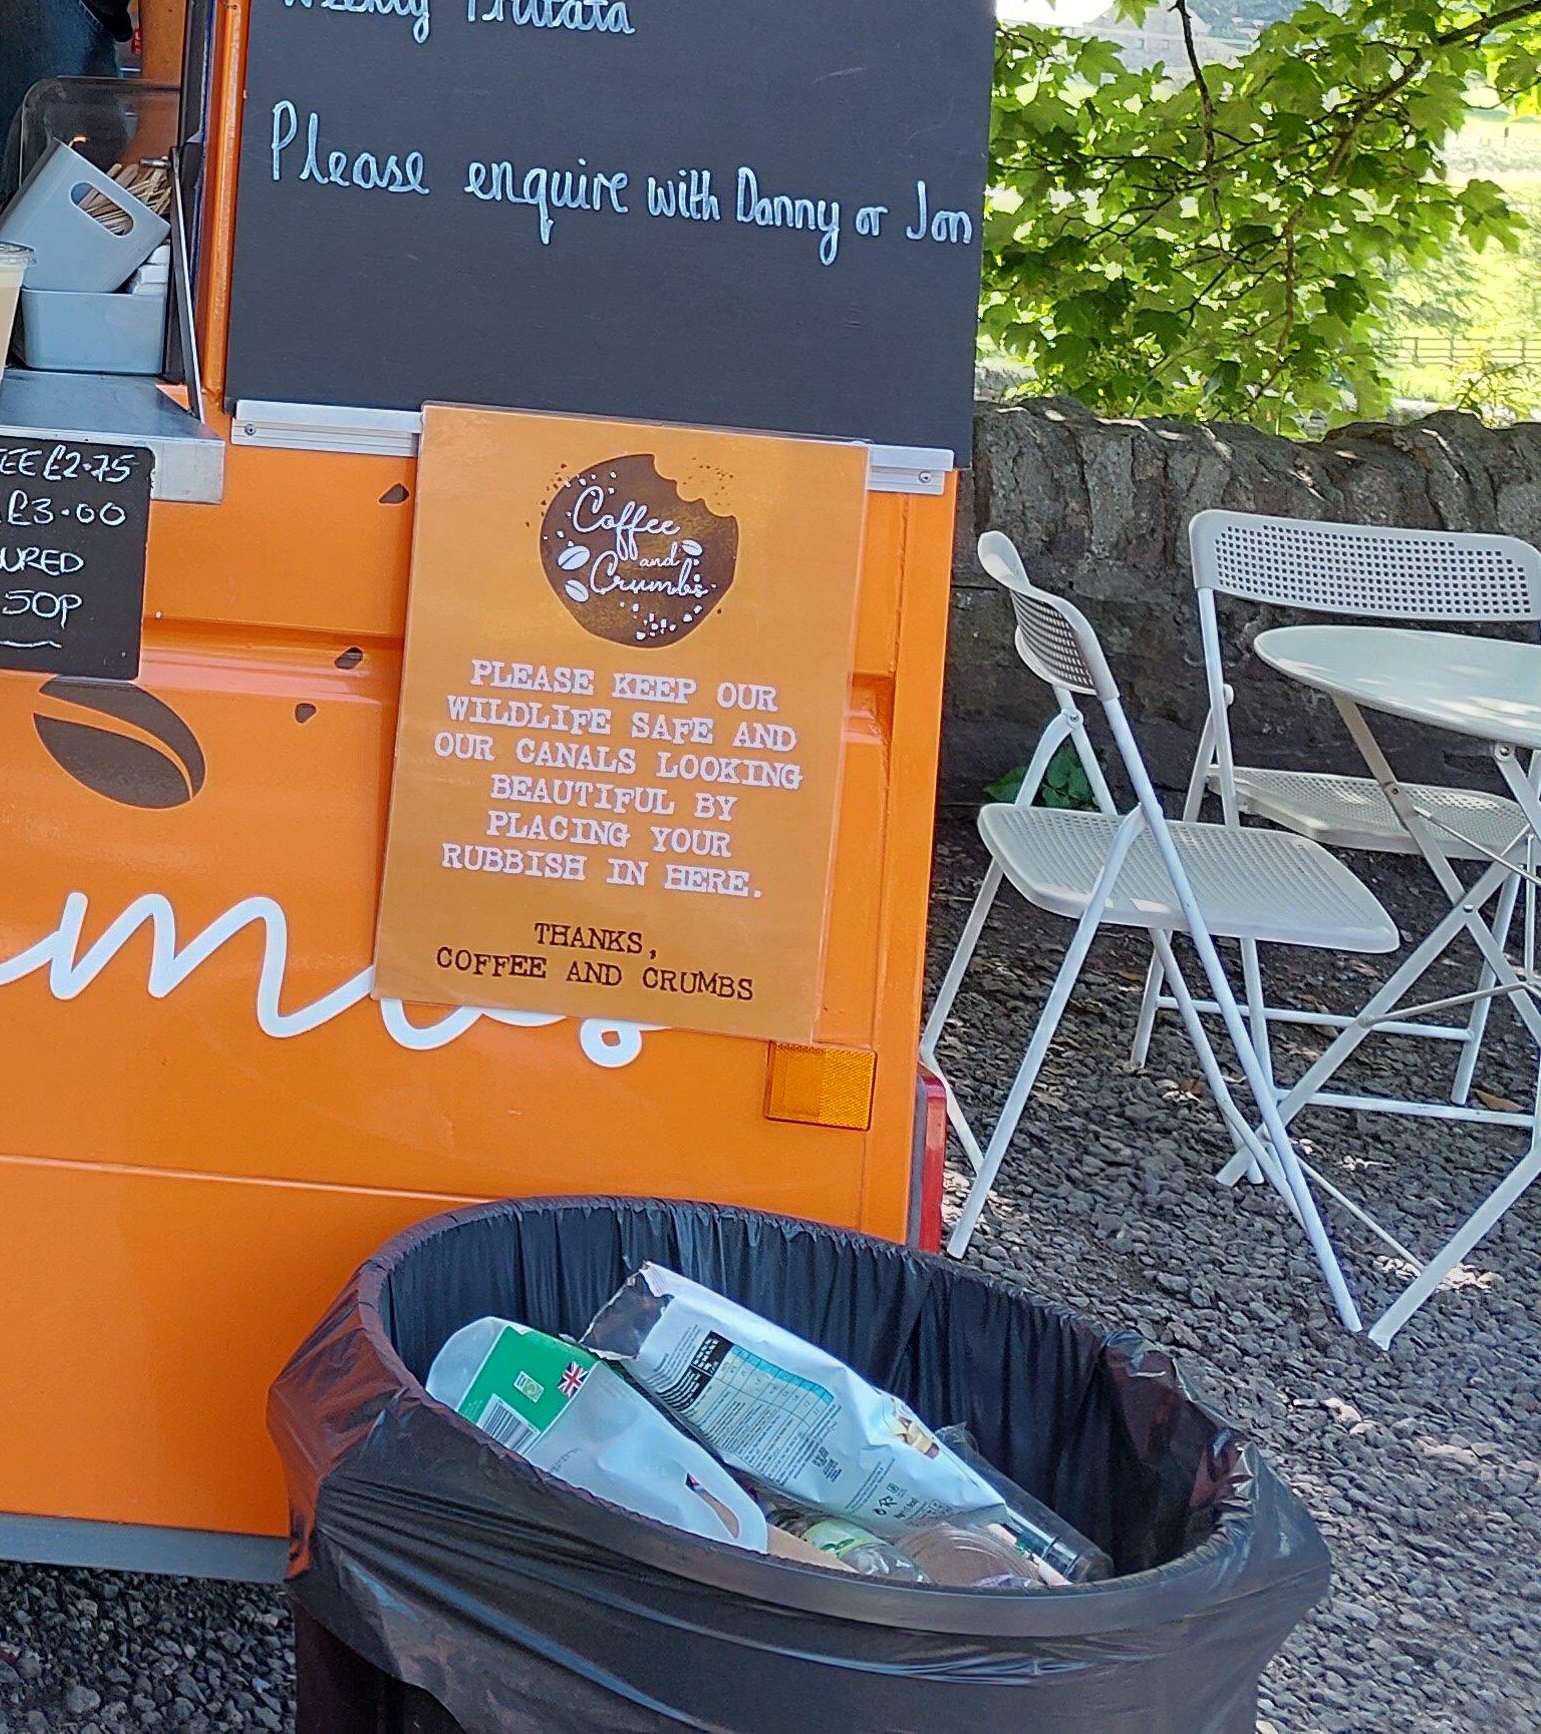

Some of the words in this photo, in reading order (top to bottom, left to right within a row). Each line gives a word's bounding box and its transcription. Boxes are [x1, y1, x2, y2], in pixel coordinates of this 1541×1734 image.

[272, 101, 429, 193] Please
[465, 159, 628, 244] enquire
[648, 170, 720, 220] with
[737, 167, 839, 265] Danny
[856, 207, 887, 235] or
[907, 181, 972, 243] Jon
[573, 485, 681, 561] Coffee
[589, 548, 708, 598] Crumbs
[641, 542, 679, 568] and
[471, 660, 595, 696] PLEASE
[612, 672, 696, 704] KEEP
[717, 682, 776, 712] OUR
[447, 695, 611, 735] WILDLIFE
[632, 714, 713, 744] SAFE
[732, 722, 797, 752] AND
[435, 732, 493, 762] OUR
[516, 738, 635, 774] CANALS
[657, 752, 802, 789] LOOKING
[491, 775, 675, 814] BEAUTIFUL
[695, 794, 738, 821] BY
[487, 812, 630, 848] PLACING
[651, 827, 731, 857] YOUR
[442, 844, 587, 881] RUBBISH
[607, 858, 646, 886] IN
[665, 867, 761, 898] HERE.
[535, 922, 657, 958] THANKS,
[437, 947, 547, 978] COFFEE
[567, 962, 622, 986] AND
[643, 970, 753, 1001] CRUMBS
